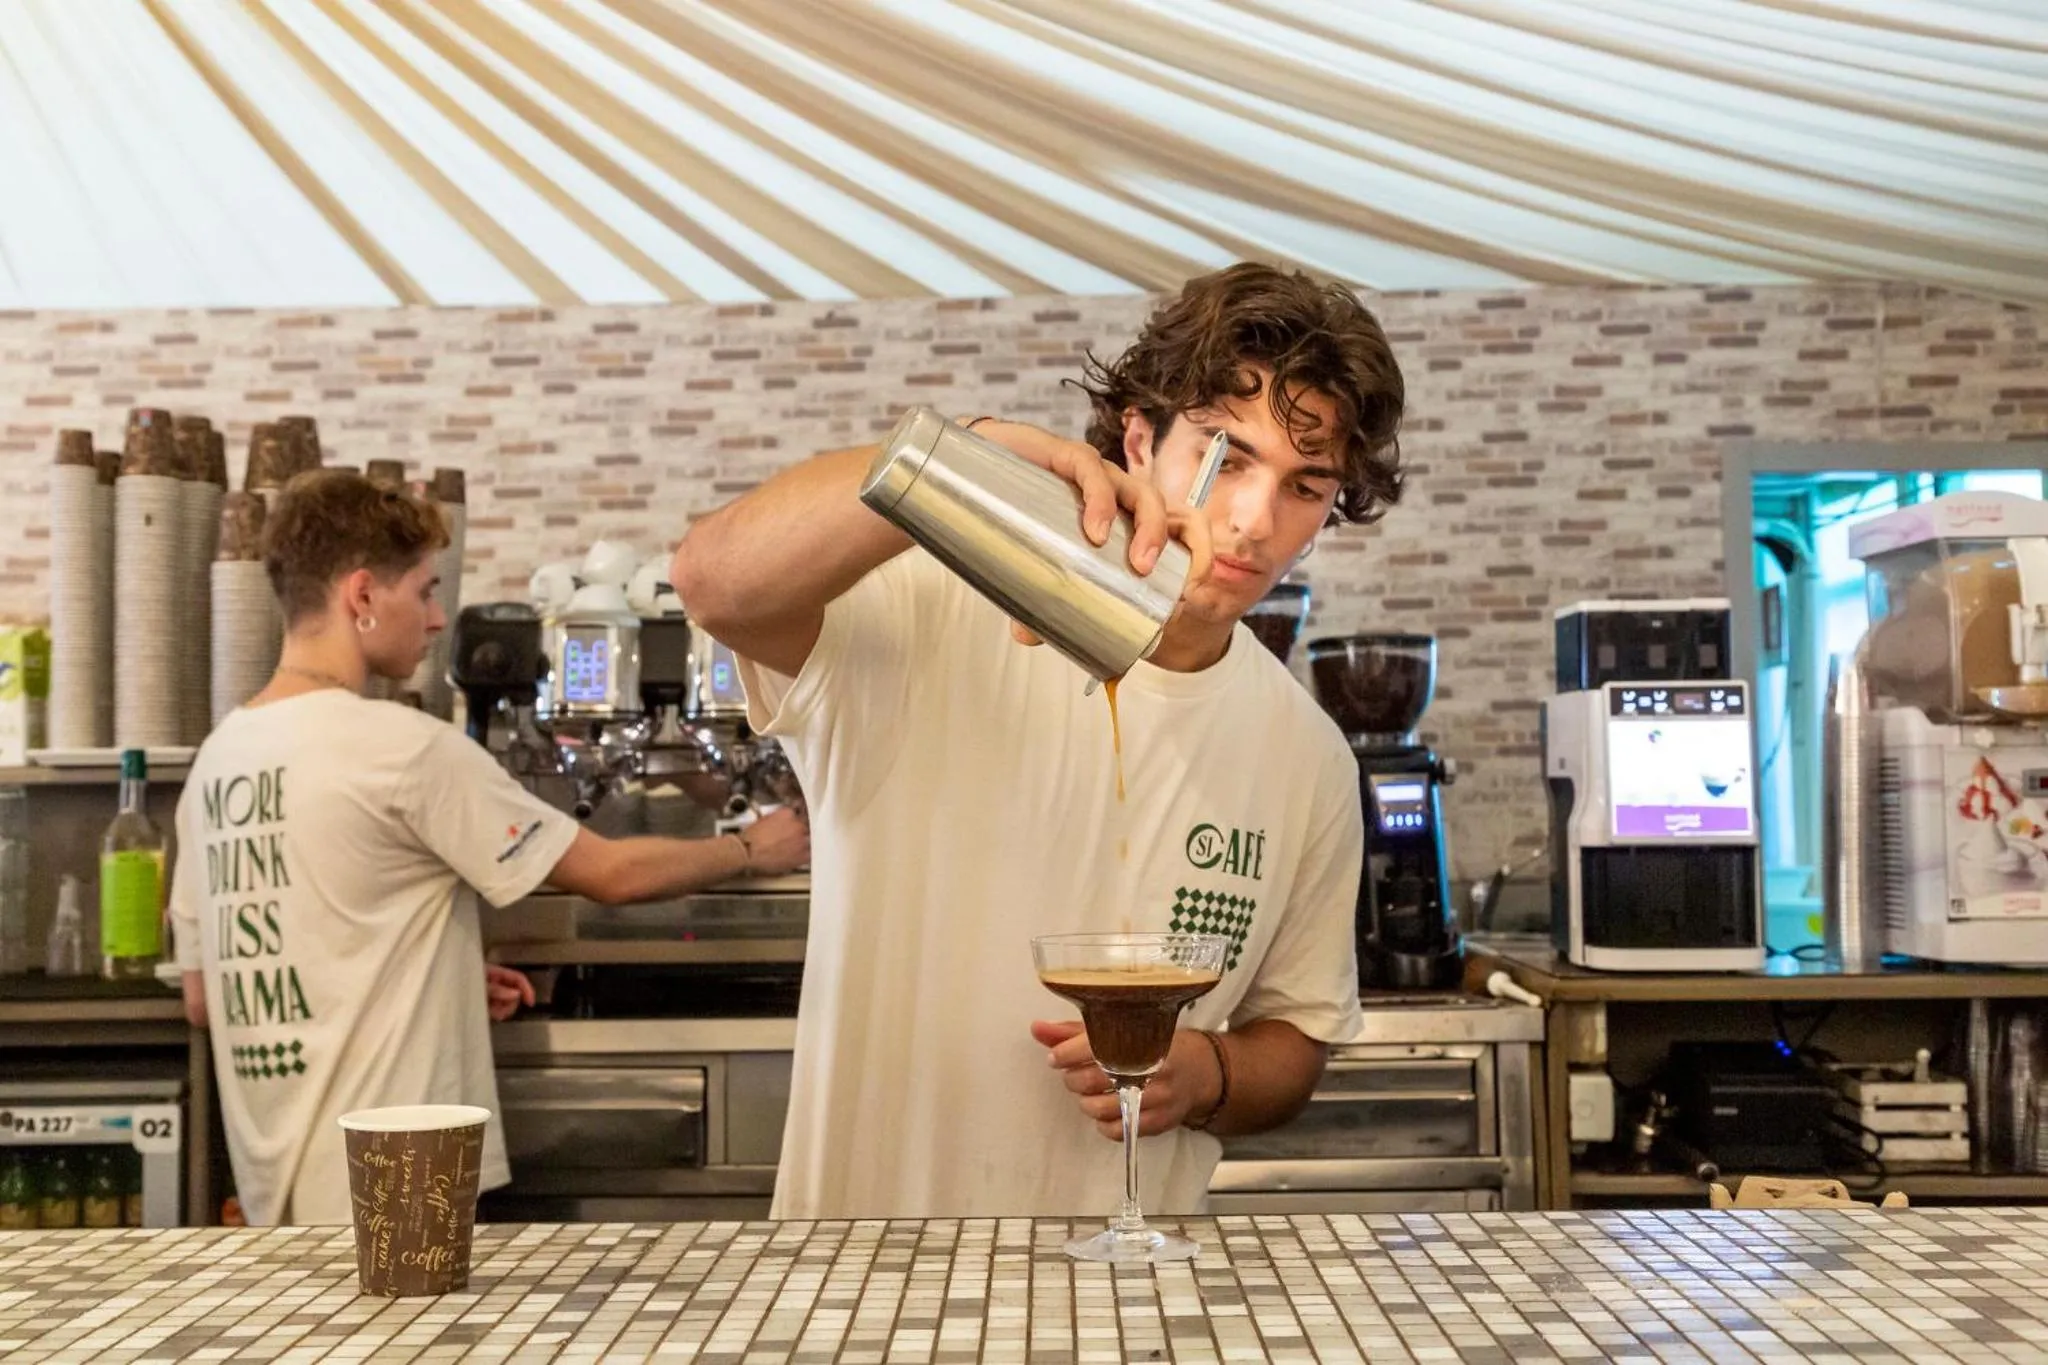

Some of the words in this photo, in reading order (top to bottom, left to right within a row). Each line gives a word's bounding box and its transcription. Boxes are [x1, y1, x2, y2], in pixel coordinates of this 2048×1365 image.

[203, 766, 287, 831] MORE
[206, 831, 291, 897] DRINK
[41, 1116, 73, 1133] 227
[140, 1118, 173, 1138] 02
